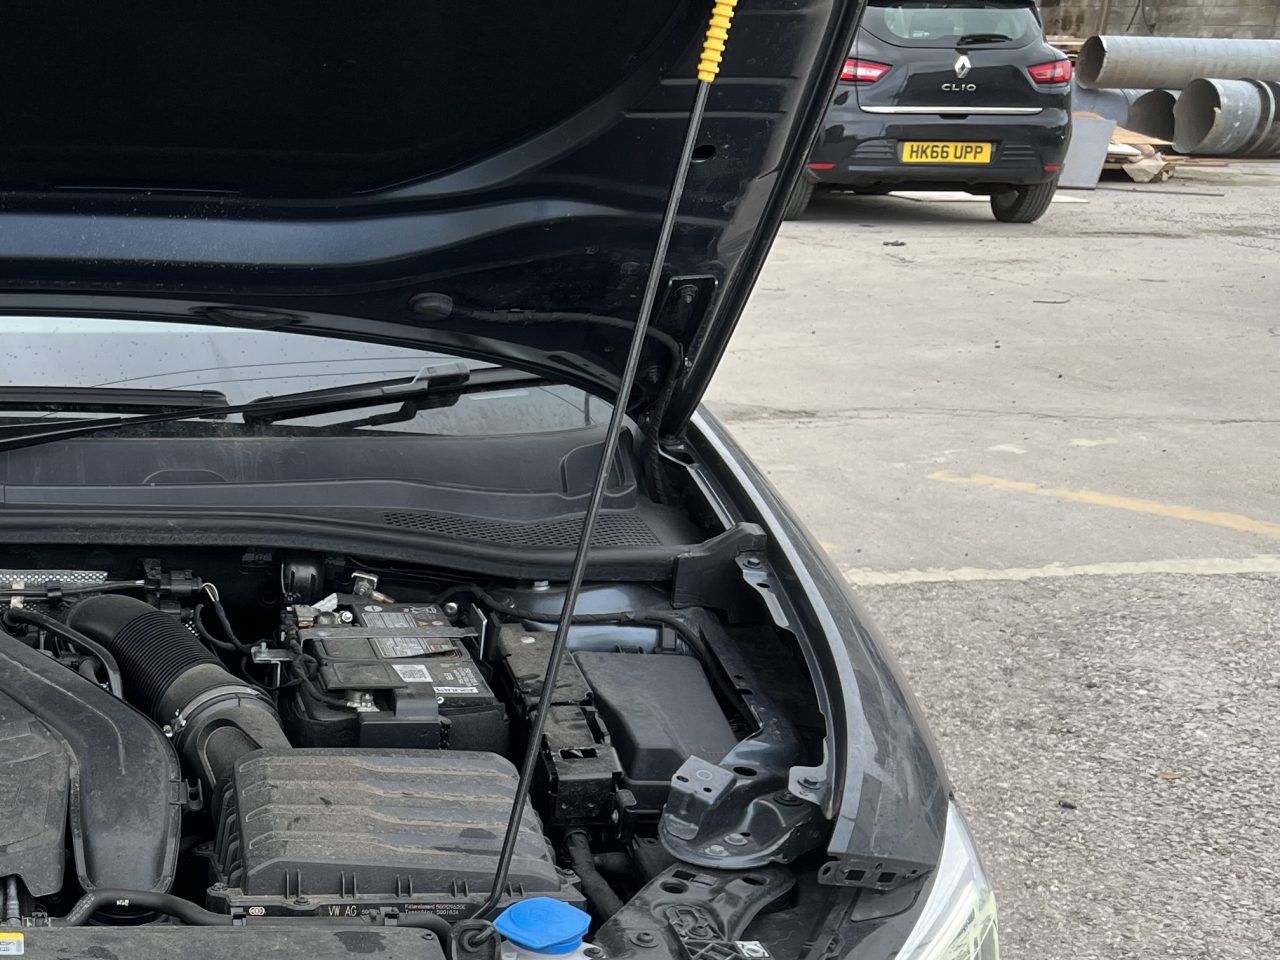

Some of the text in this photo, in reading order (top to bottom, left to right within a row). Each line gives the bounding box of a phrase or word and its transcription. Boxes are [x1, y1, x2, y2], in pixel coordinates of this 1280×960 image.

[941, 83, 977, 91] CLIO
[909, 144, 984, 160] HK66 UPP
[328, 905, 340, 917] VW
[344, 905, 357, 917] AG
